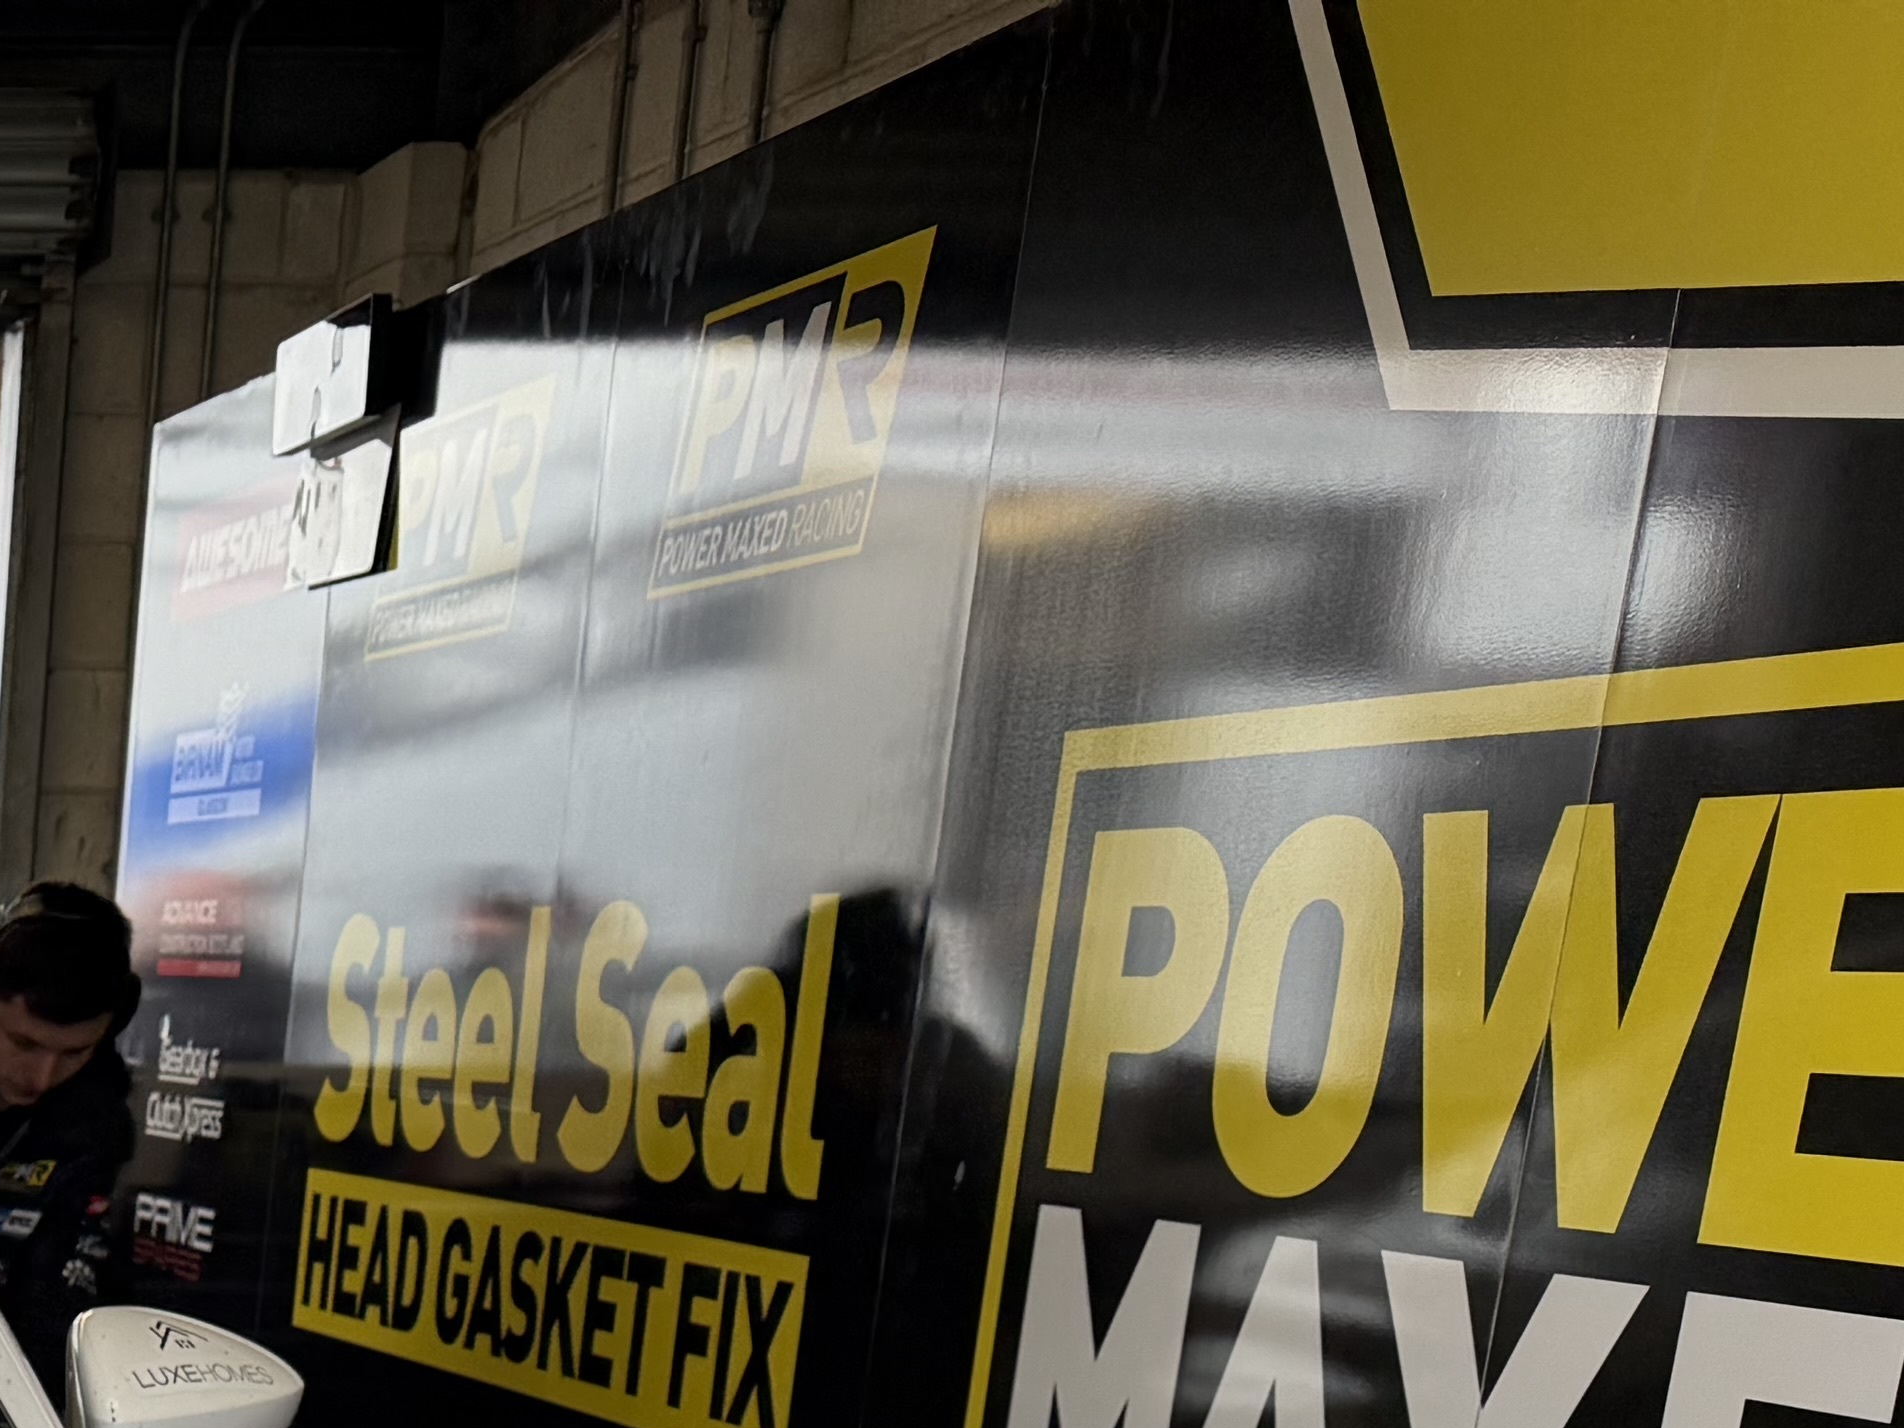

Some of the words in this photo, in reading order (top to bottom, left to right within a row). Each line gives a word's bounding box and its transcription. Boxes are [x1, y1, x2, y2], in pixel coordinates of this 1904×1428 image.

[679, 280, 906, 493] PMR
[399, 412, 538, 573] PMR
[659, 526, 722, 577] POWER
[722, 511, 791, 564] MAXED
[791, 488, 865, 549] RACING
[314, 905, 552, 1163] Steel
[556, 892, 841, 1200] Seal
[134, 1364, 275, 1390] LUXEHOMES
[301, 1193, 430, 1331] HEAD
[435, 1217, 665, 1396] GASKET
